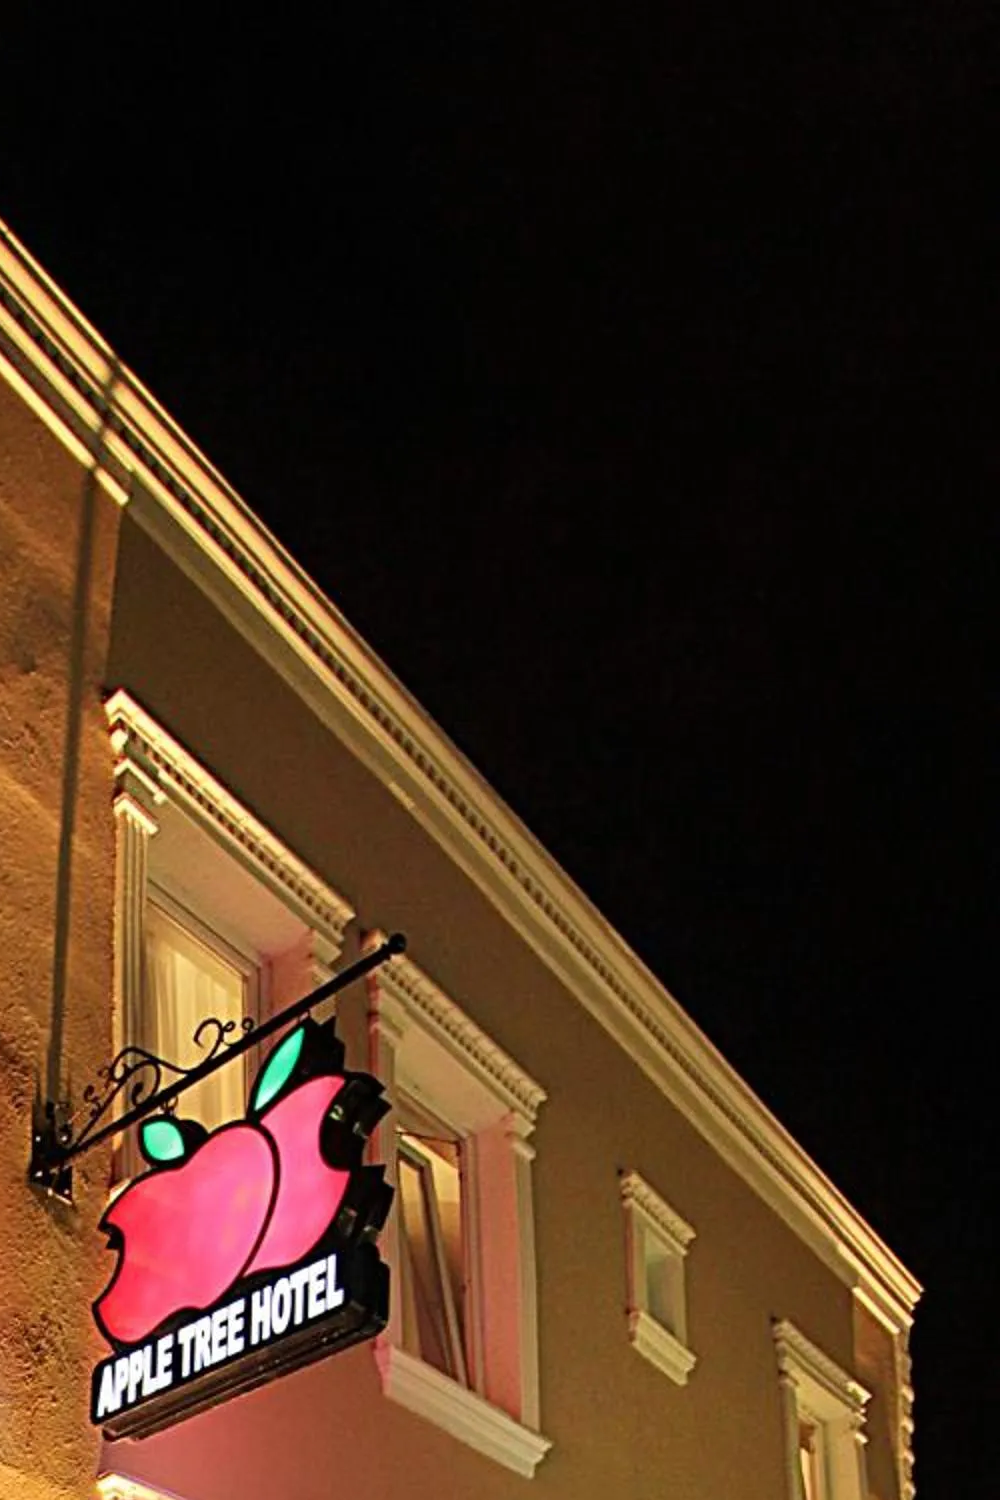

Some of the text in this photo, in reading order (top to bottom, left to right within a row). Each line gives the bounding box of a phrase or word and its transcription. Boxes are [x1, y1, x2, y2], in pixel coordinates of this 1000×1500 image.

[96, 1253, 345, 1418] APPLE TREE HOTEL
